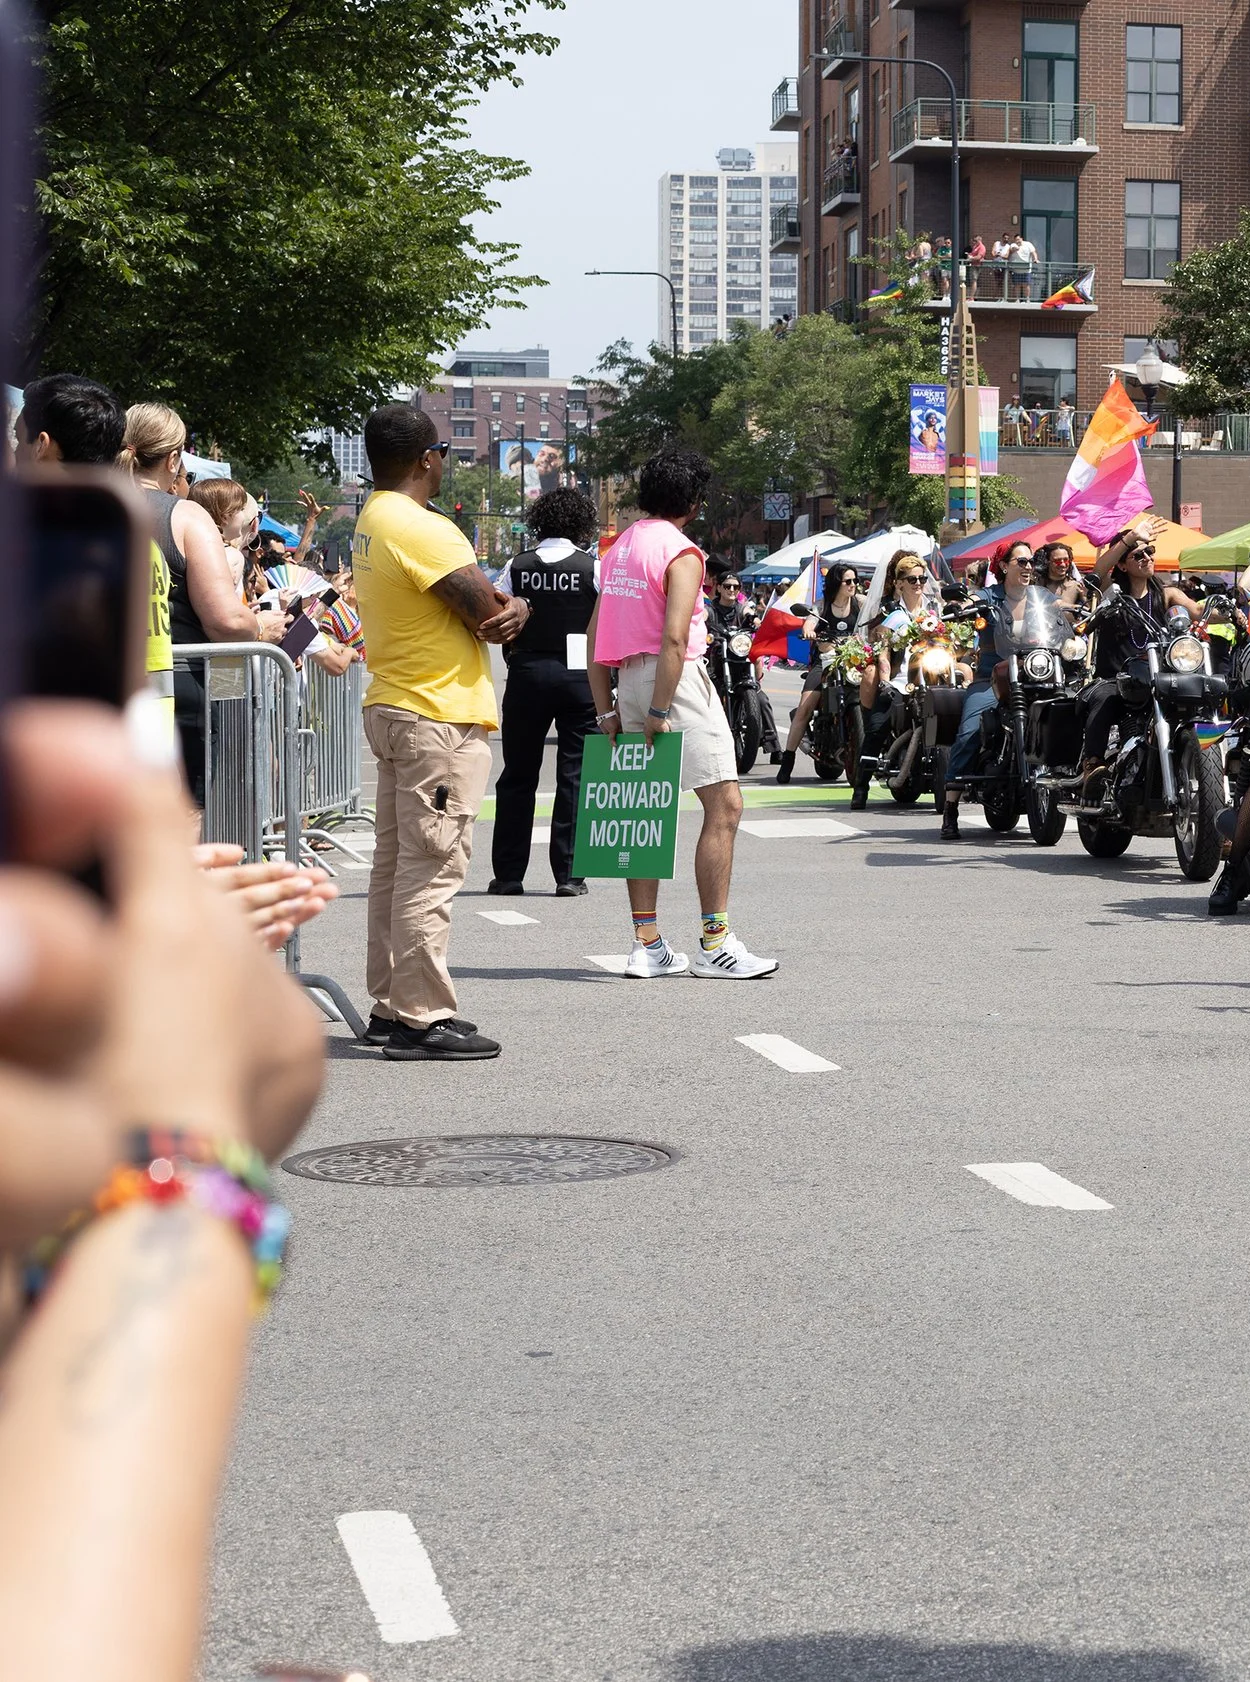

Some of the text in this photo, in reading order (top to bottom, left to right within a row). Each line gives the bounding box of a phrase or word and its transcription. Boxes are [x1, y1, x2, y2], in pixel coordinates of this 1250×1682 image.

[941, 317, 950, 375] HA3625
[521, 571, 580, 591] POLICE
[610, 743, 655, 771] KEEP
[585, 781, 673, 809] FORWARD
[589, 819, 663, 847] MOTION
